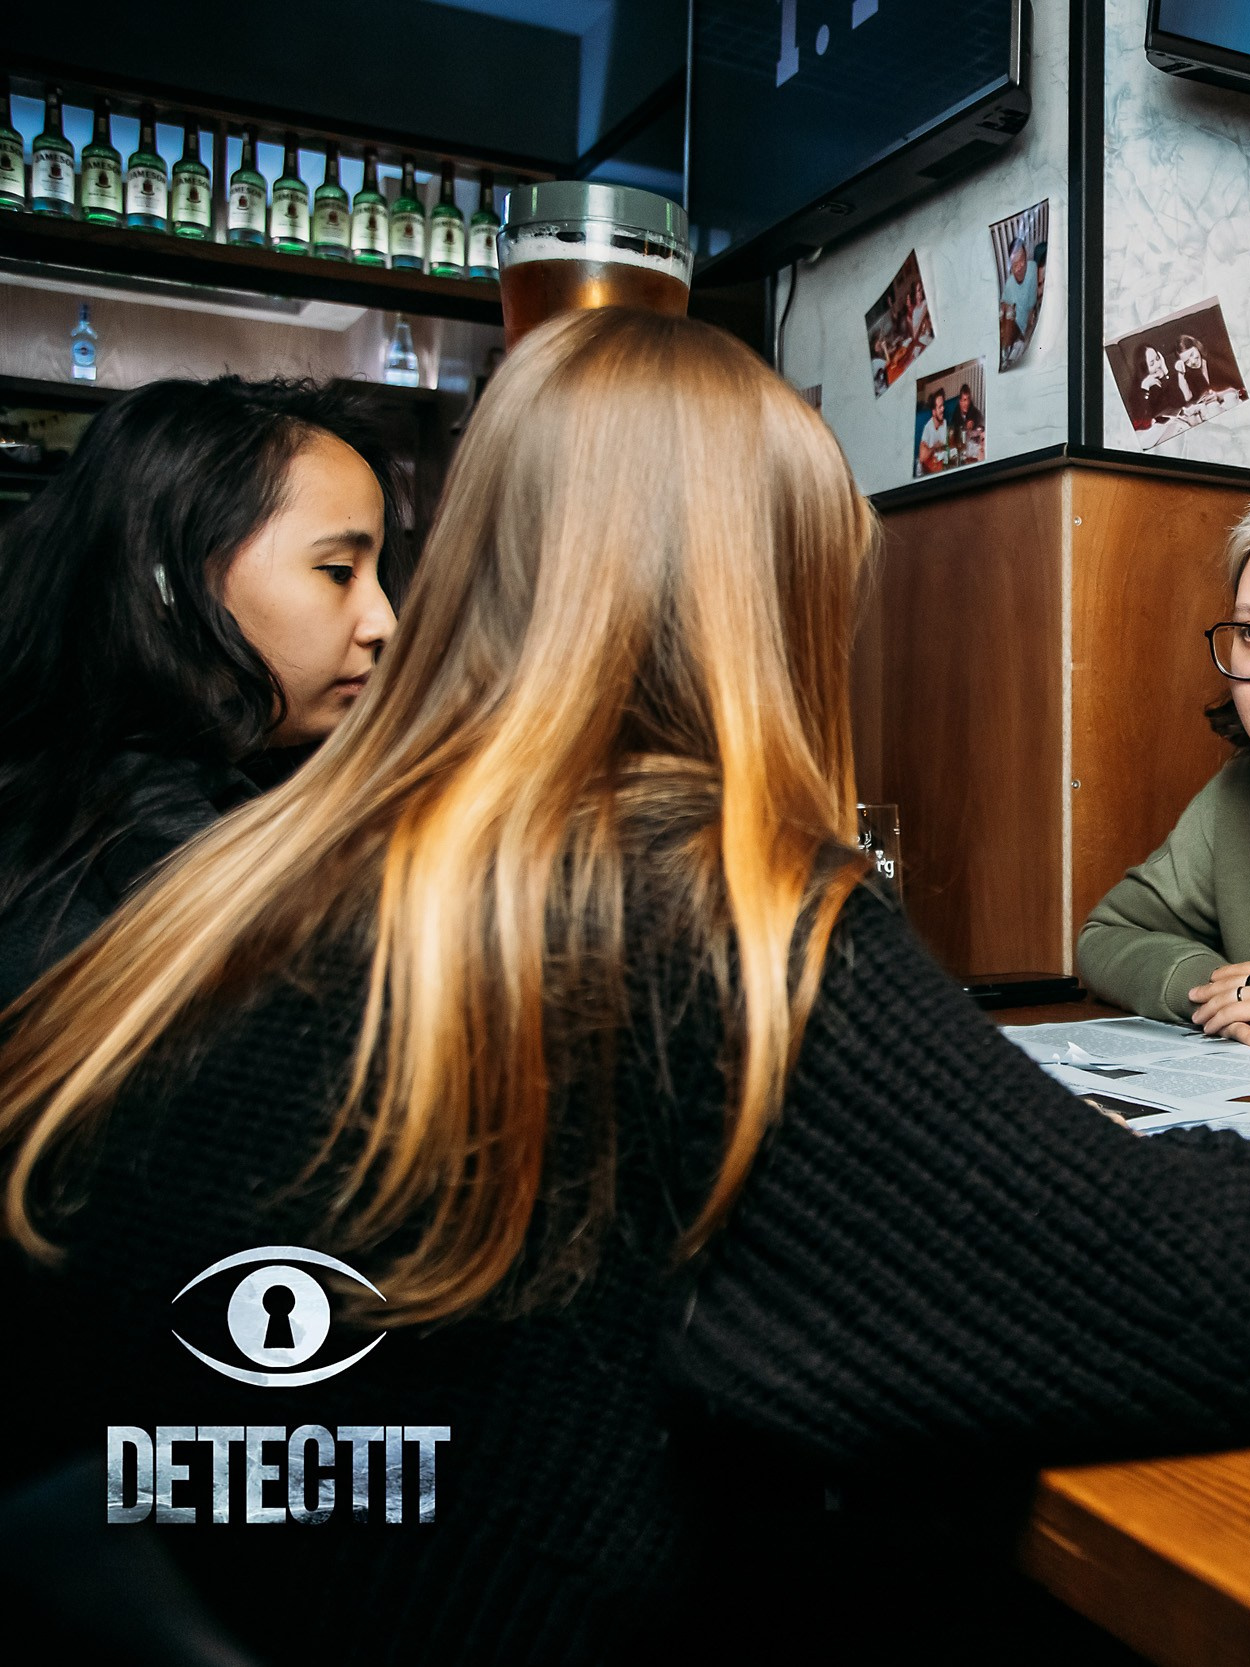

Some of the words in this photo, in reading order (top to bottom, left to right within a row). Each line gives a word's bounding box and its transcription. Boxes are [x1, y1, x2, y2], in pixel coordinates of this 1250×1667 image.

[34, 152, 74, 169] JAMESON
[129, 169, 166, 184] JAMESON
[230, 186, 262, 199] AMESON
